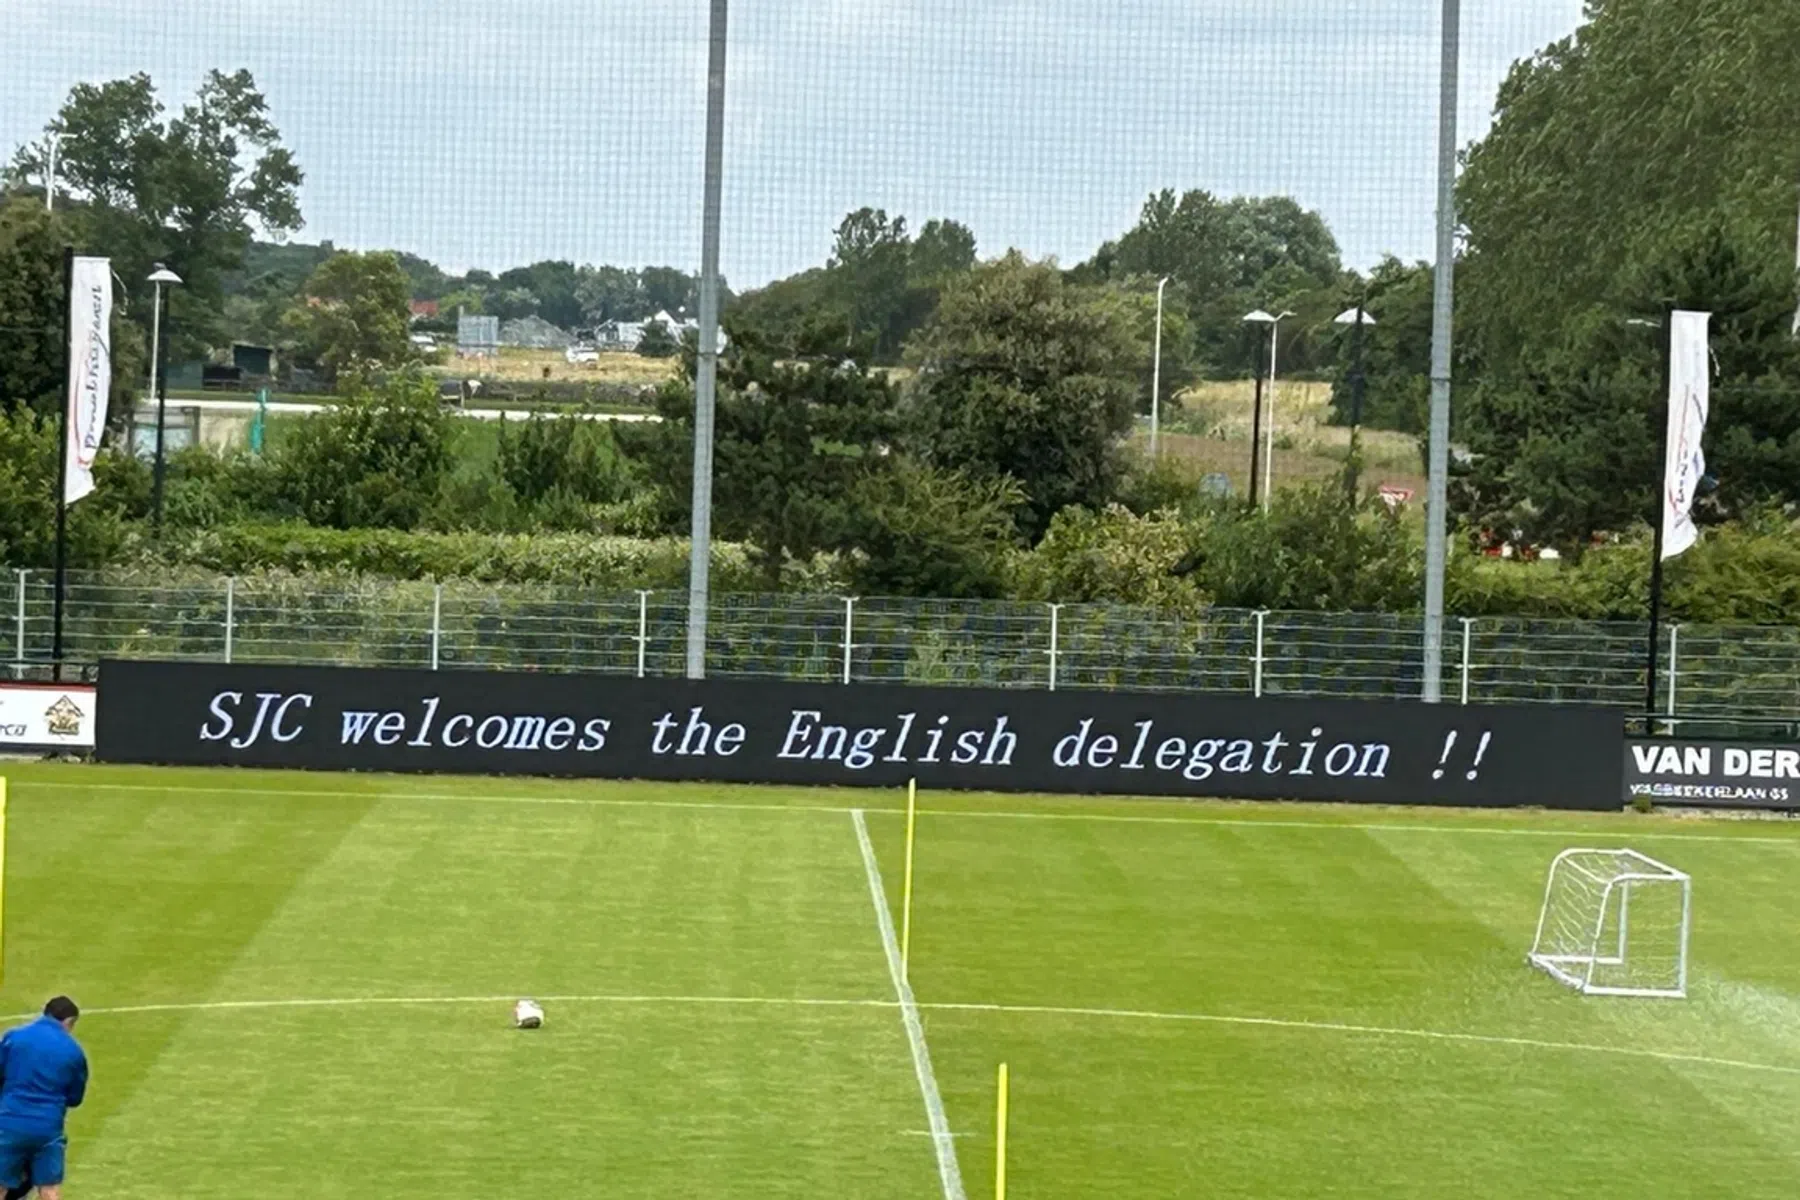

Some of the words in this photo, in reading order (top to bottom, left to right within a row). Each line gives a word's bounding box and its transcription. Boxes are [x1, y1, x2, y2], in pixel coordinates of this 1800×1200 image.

[200, 691, 312, 748] SJC
[342, 697, 610, 751] welcomes
[652, 706, 745, 755] the
[777, 710, 1017, 768] English
[1053, 718, 1389, 780] delegation
[1432, 730, 1491, 780] !!
[1632, 746, 1711, 775] VAN
[1723, 748, 1800, 778] DER
